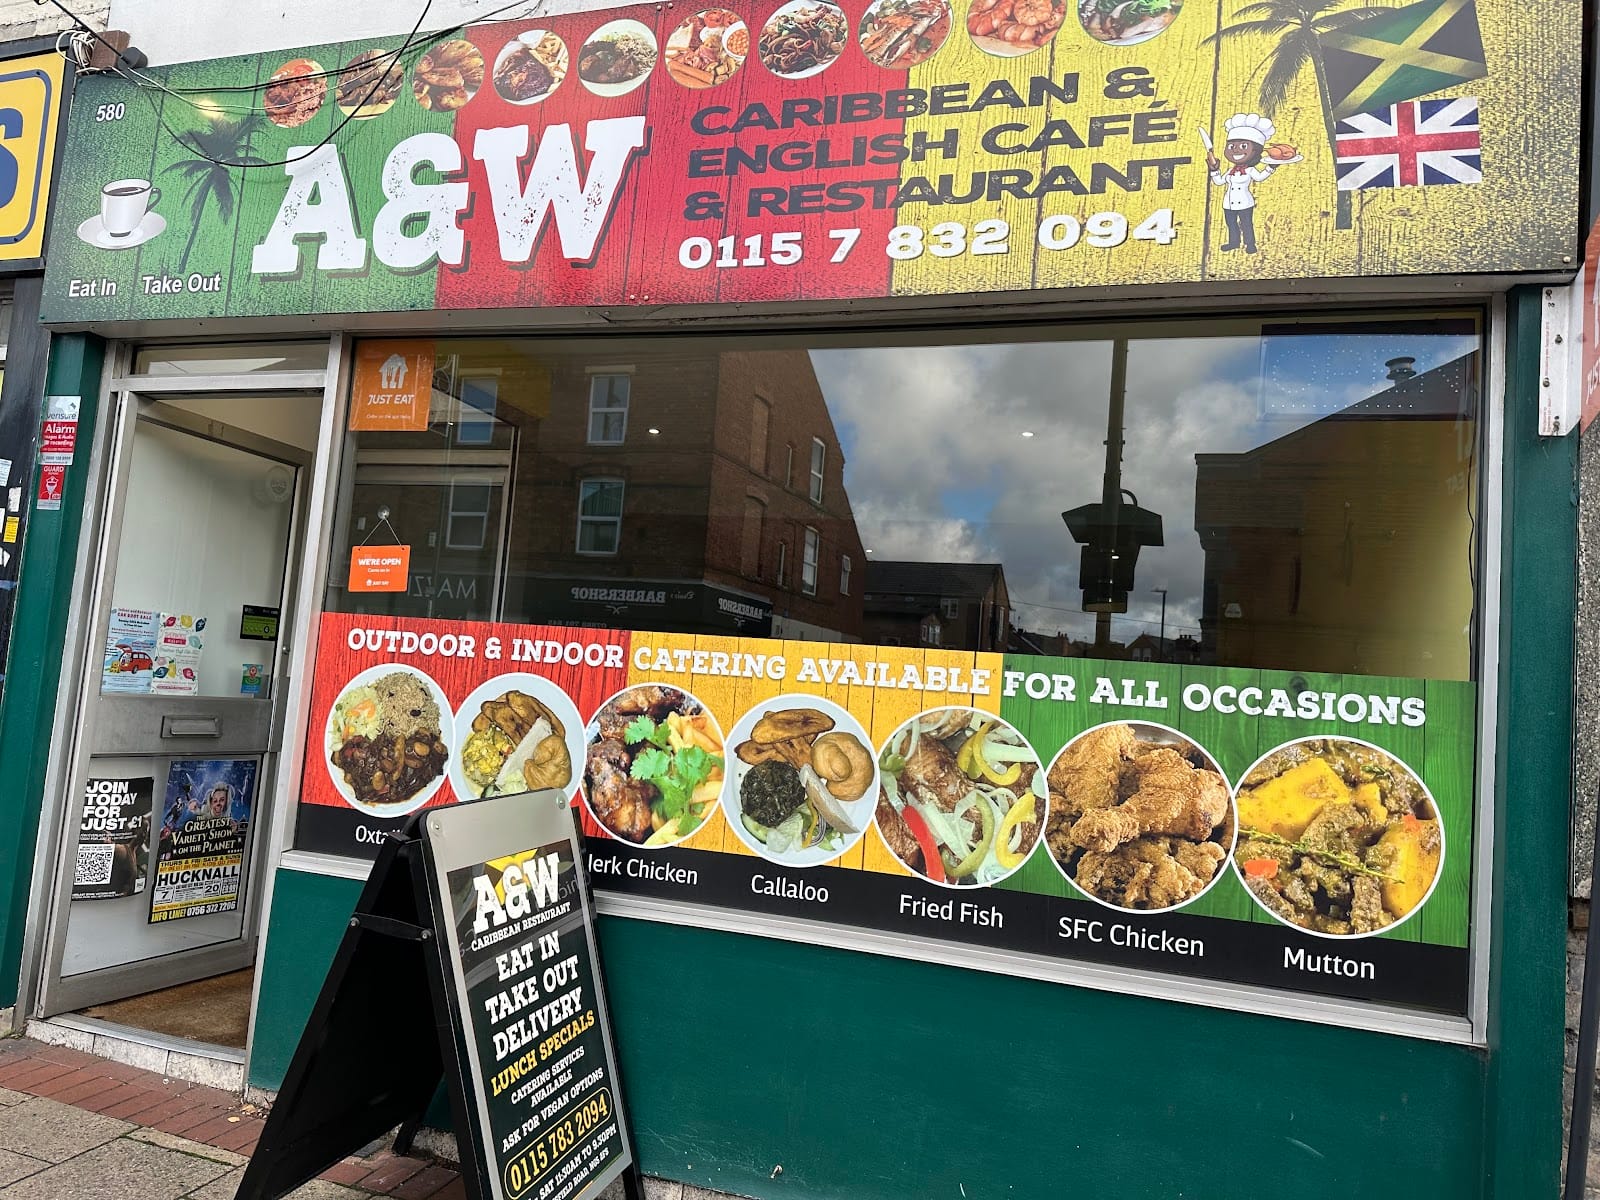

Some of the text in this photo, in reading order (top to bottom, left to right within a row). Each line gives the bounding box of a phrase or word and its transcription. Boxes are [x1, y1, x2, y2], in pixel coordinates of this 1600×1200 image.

[96, 102, 125, 121] 580
[690, 66, 1155, 136] CARIBBEAN &
[688, 100, 1178, 180] ENGLISH CAFÉ
[250, 116, 651, 277] A&W
[682, 156, 1192, 222] & RESTAURANT
[678, 208, 1178, 271] 0115 7 832 094
[68, 277, 118, 297] Eat In
[142, 272, 221, 296] Take Out
[368, 394, 414, 405] JUST EAT
[45, 424, 75, 434] Alarm
[381, 558, 402, 566] OPEN
[348, 628, 1426, 726] OUTDOOR & INDOOR CATERING AVAILABLE FOR ALL OCCASIONS
[85, 793, 137, 806] TODAY
[86, 781, 128, 794] JOIN
[81, 818, 127, 831] JUST
[83, 806, 121, 818] FOR
[158, 865, 238, 886] HUCKNALL
[205, 884, 219, 893] 20
[627, 858, 698, 885] Chicken
[751, 873, 829, 905] Callaloo
[162, 891, 168, 899] 7
[473, 853, 559, 934] A&W
[900, 894, 1004, 928] Fried Fish
[152, 911, 167, 922] INFO
[187, 906, 205, 916] 0756
[471, 902, 571, 951] CARIBBEAN RESTAURANT
[496, 930, 561, 980] EAT IN
[1059, 916, 1205, 957] SFC Chicken
[1283, 946, 1375, 981] Mutton
[485, 955, 579, 1025] TAKE OUT
[492, 987, 583, 1061] DELIVERY
[491, 1009, 596, 1097] LUNCH SPECIALS
[510, 1046, 585, 1105] CATERING SERVICES
[530, 1069, 573, 1108] AVAILABLE
[502, 1067, 604, 1153] ASK FOR VEGAN OPTIONS
[510, 1092, 608, 1191] 0115 783 2094
[539, 1178, 555, 1200] SAT
[581, 1146, 592, 1161] TO
